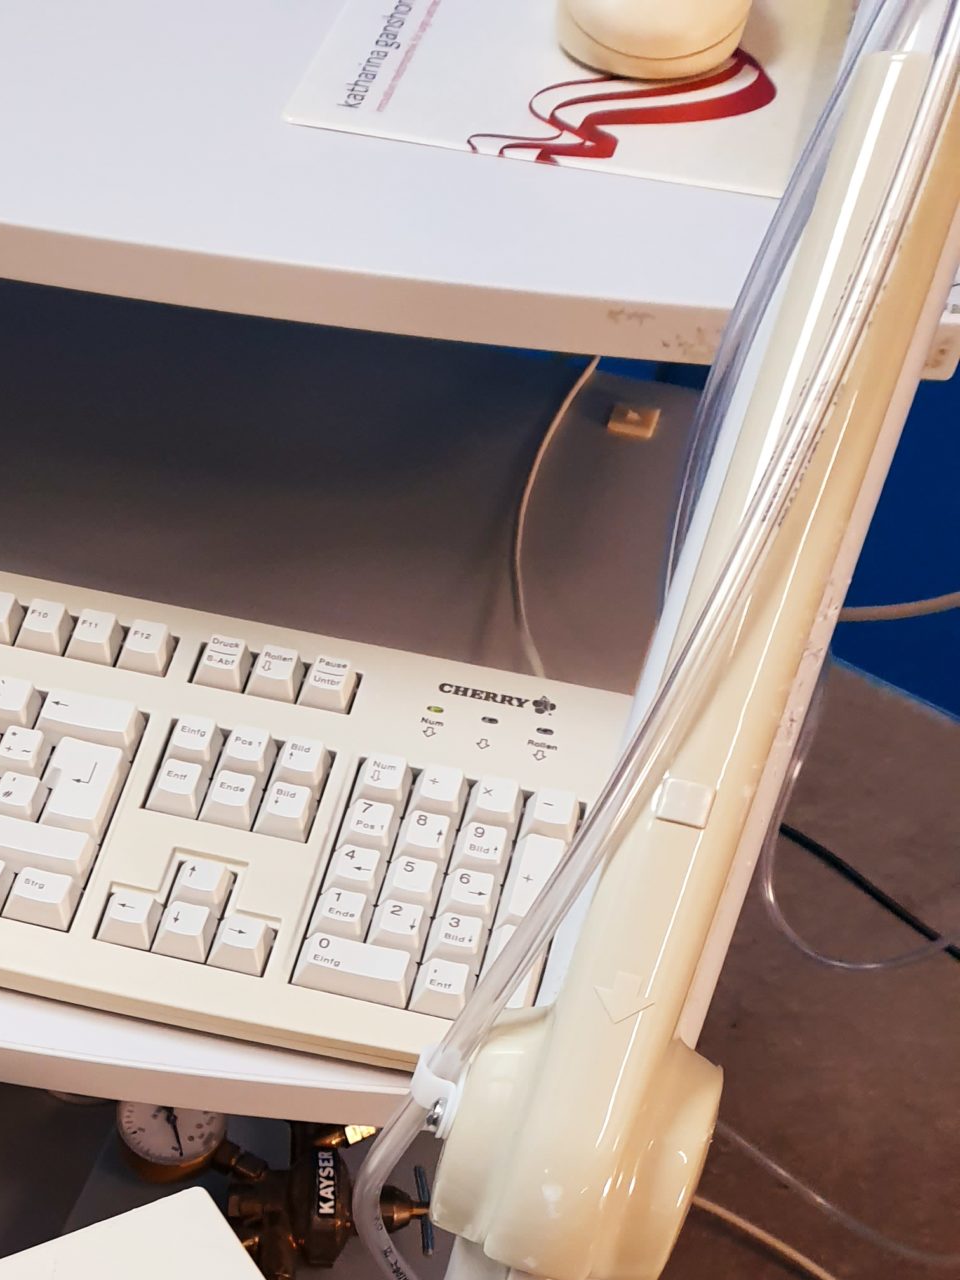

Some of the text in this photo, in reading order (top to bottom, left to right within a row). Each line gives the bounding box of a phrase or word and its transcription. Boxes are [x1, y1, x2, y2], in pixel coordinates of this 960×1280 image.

[337, 48, 388, 109] katharina
[31, 610, 48, 618] F10
[81, 620, 98, 628] F11
[133, 630, 151, 639] F12
[212, 638, 239, 648] Druck
[264, 651, 293, 664] Rollen
[319, 658, 347, 668] Pause
[439, 683, 530, 708] CHERRY
[421, 717, 443, 729] Num
[235, 736, 253, 746] Pos
[527, 740, 557, 752] Rollen
[290, 743, 310, 755] Bild
[373, 761, 396, 773] Num
[219, 782, 245, 792] Ende
[276, 789, 296, 798] Bild
[362, 802, 373, 813] 7
[356, 820, 375, 829] Pos
[417, 815, 428, 826] 8
[474, 827, 485, 838] 9
[469, 844, 490, 854] Bild
[345, 850, 355, 860] 4
[404, 861, 415, 872] 5
[460, 873, 471, 884] 6
[336, 893, 342, 902] 1
[328, 907, 355, 917] Ende
[390, 905, 402, 916] 2
[449, 917, 460, 927] 3
[444, 933, 465, 942] Bild
[319, 938, 330, 948] 0
[319, 1151, 335, 1215] KAYSER
